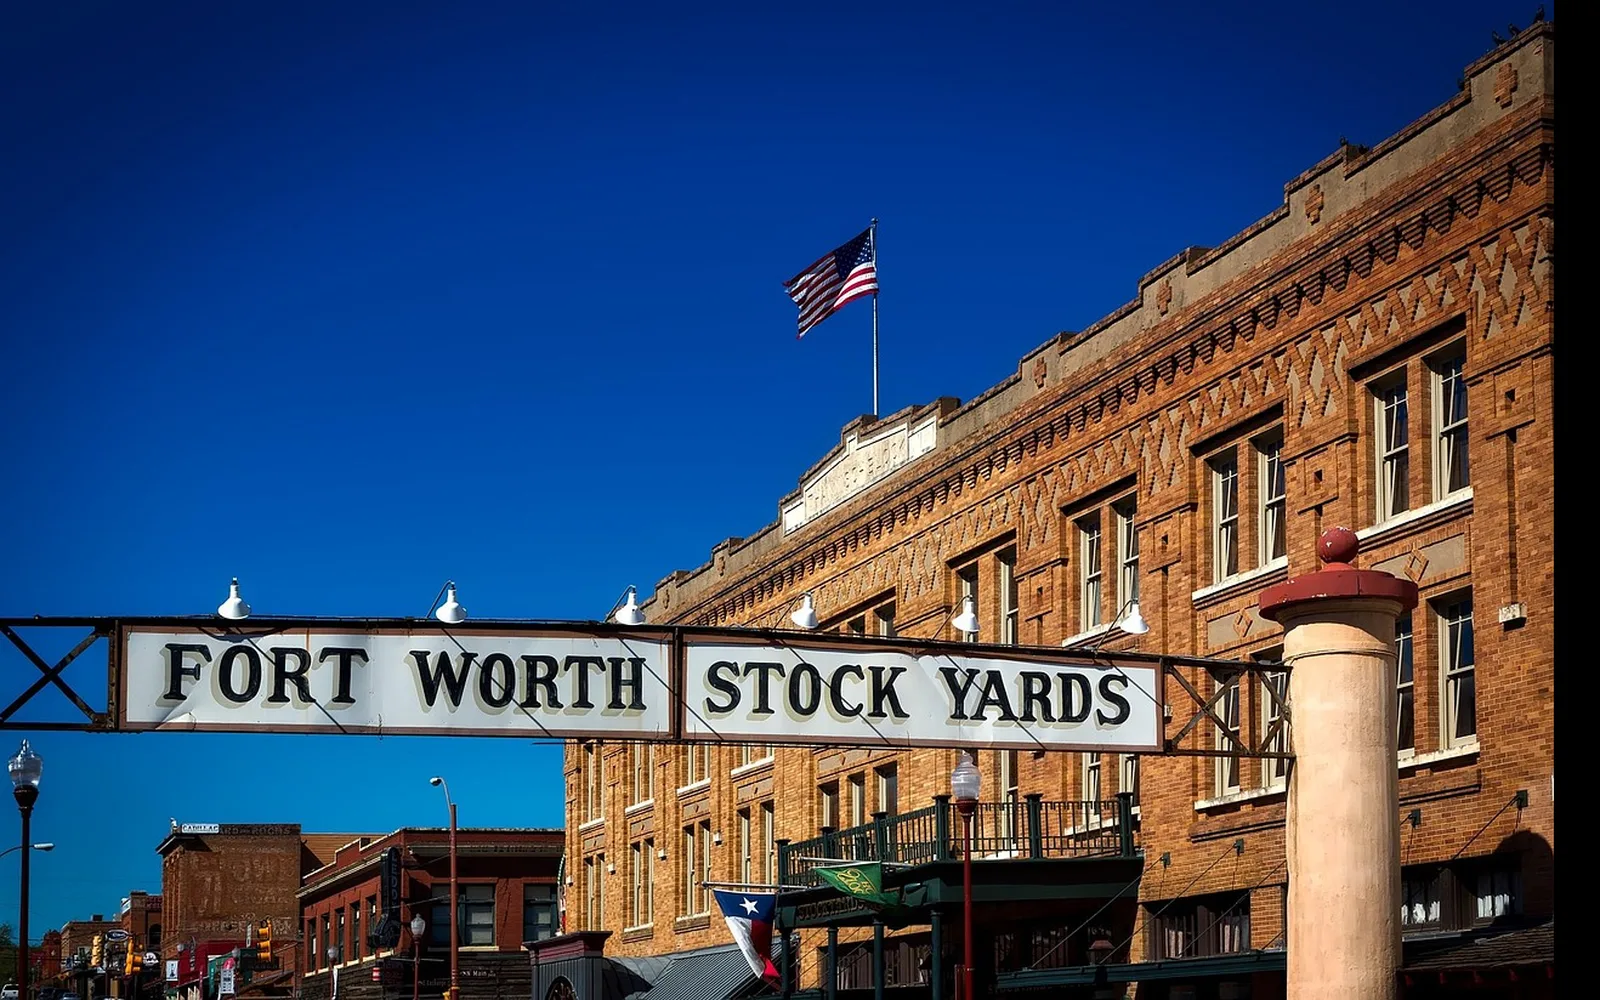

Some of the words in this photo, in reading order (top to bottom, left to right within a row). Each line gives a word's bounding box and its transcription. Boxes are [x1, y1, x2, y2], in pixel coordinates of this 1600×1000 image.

[161, 642, 369, 703] FORT
[408, 648, 647, 711] WORTH
[705, 660, 910, 719] STOCK
[939, 666, 1131, 726] YARDS
